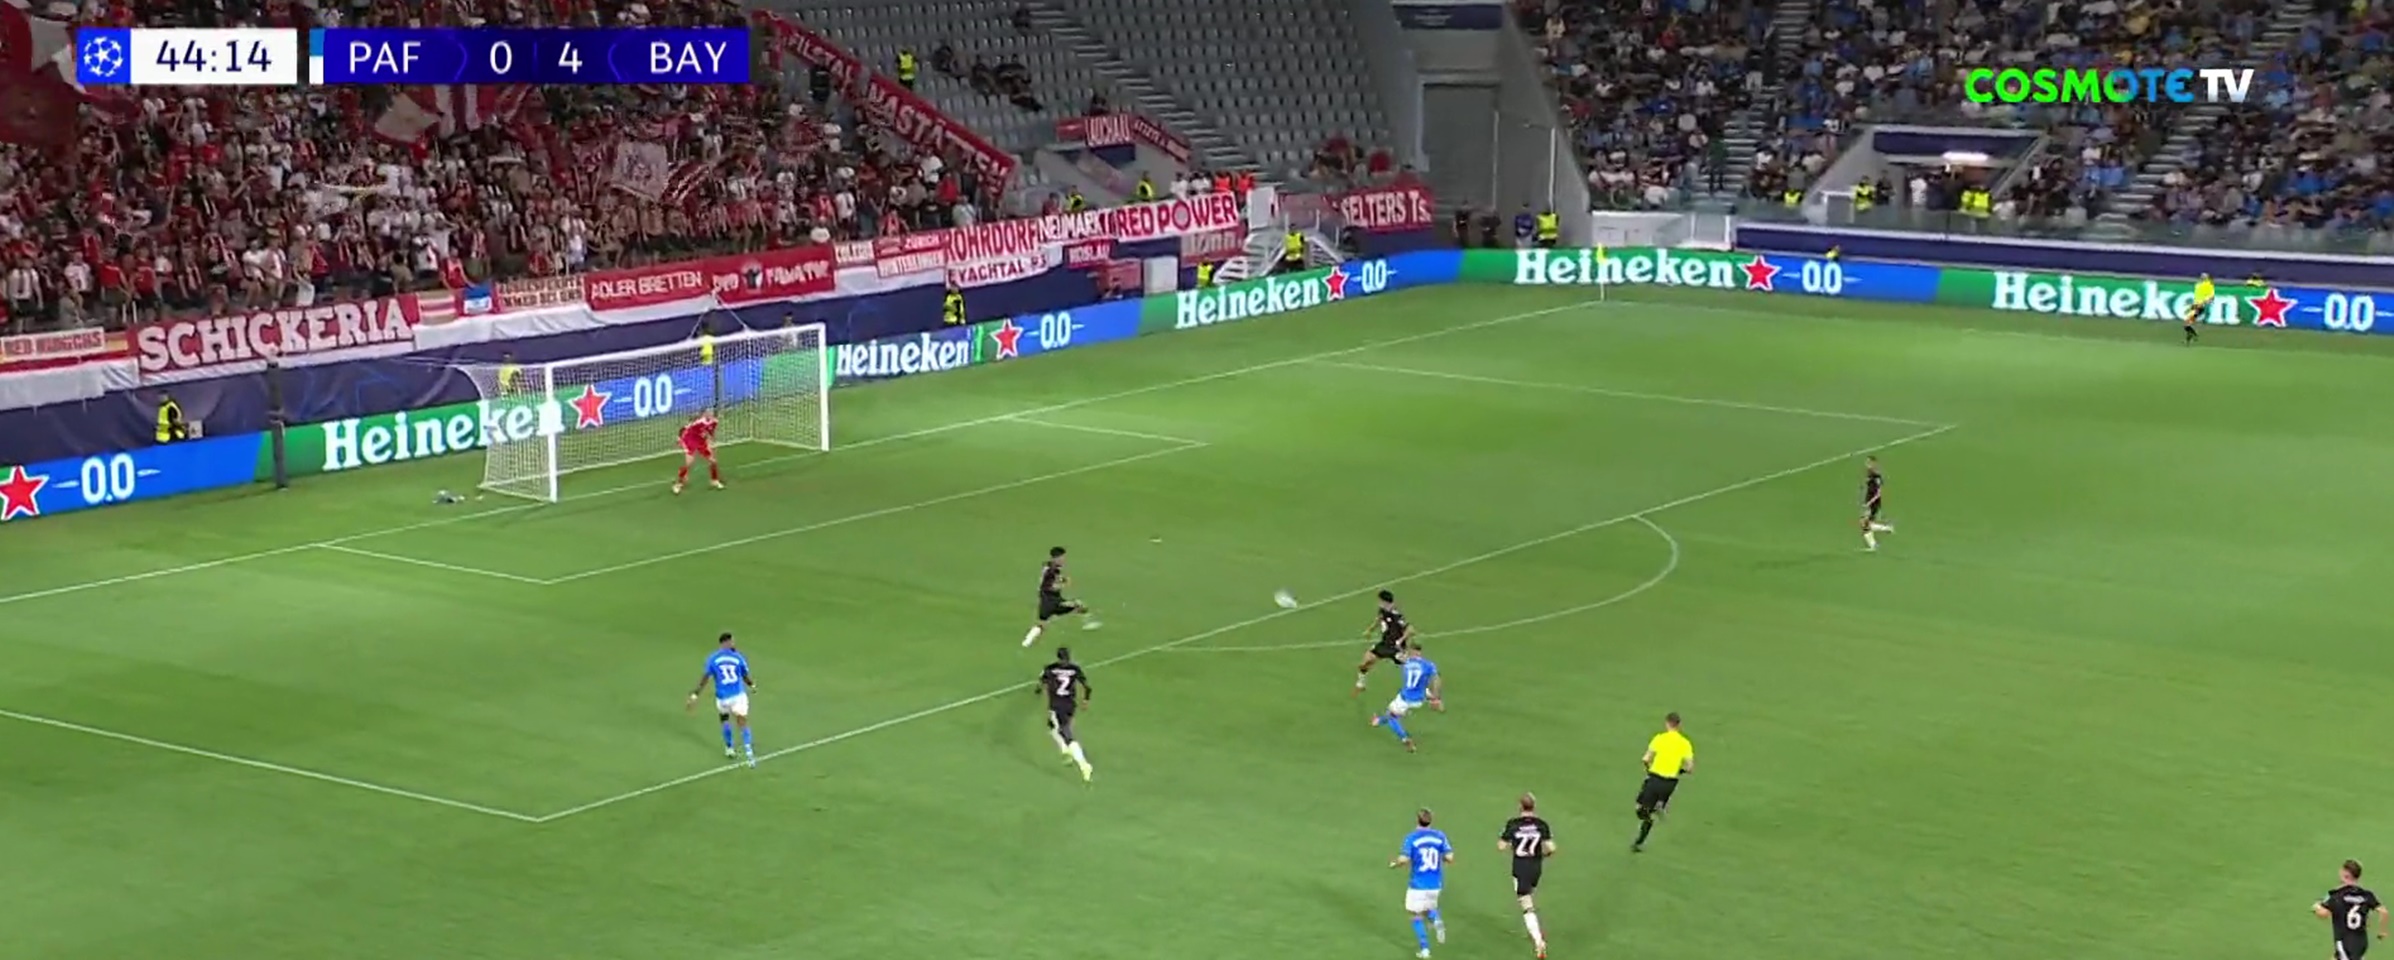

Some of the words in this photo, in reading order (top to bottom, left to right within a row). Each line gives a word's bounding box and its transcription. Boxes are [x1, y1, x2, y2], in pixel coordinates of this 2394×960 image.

[1118, 206, 1154, 237] RED
[1159, 194, 1237, 233] POWER
[1341, 191, 1407, 227] SELTERS
[947, 217, 1038, 262] ROHRDORF
[590, 278, 637, 300] ADLER
[638, 270, 703, 295] BRETTEN
[1515, 248, 1735, 288] Heineken
[1175, 271, 1321, 329] Heineken
[1992, 271, 2240, 325] Heineken
[137, 298, 413, 372] SCHICKERIA
[835, 332, 970, 377] Heineken
[321, 396, 565, 472] Heineken
[1056, 676, 1071, 696] 2
[1406, 669, 1423, 689] 17
[1418, 847, 1439, 872] 30
[1514, 831, 1542, 857] 27
[2346, 904, 2362, 930] 6
